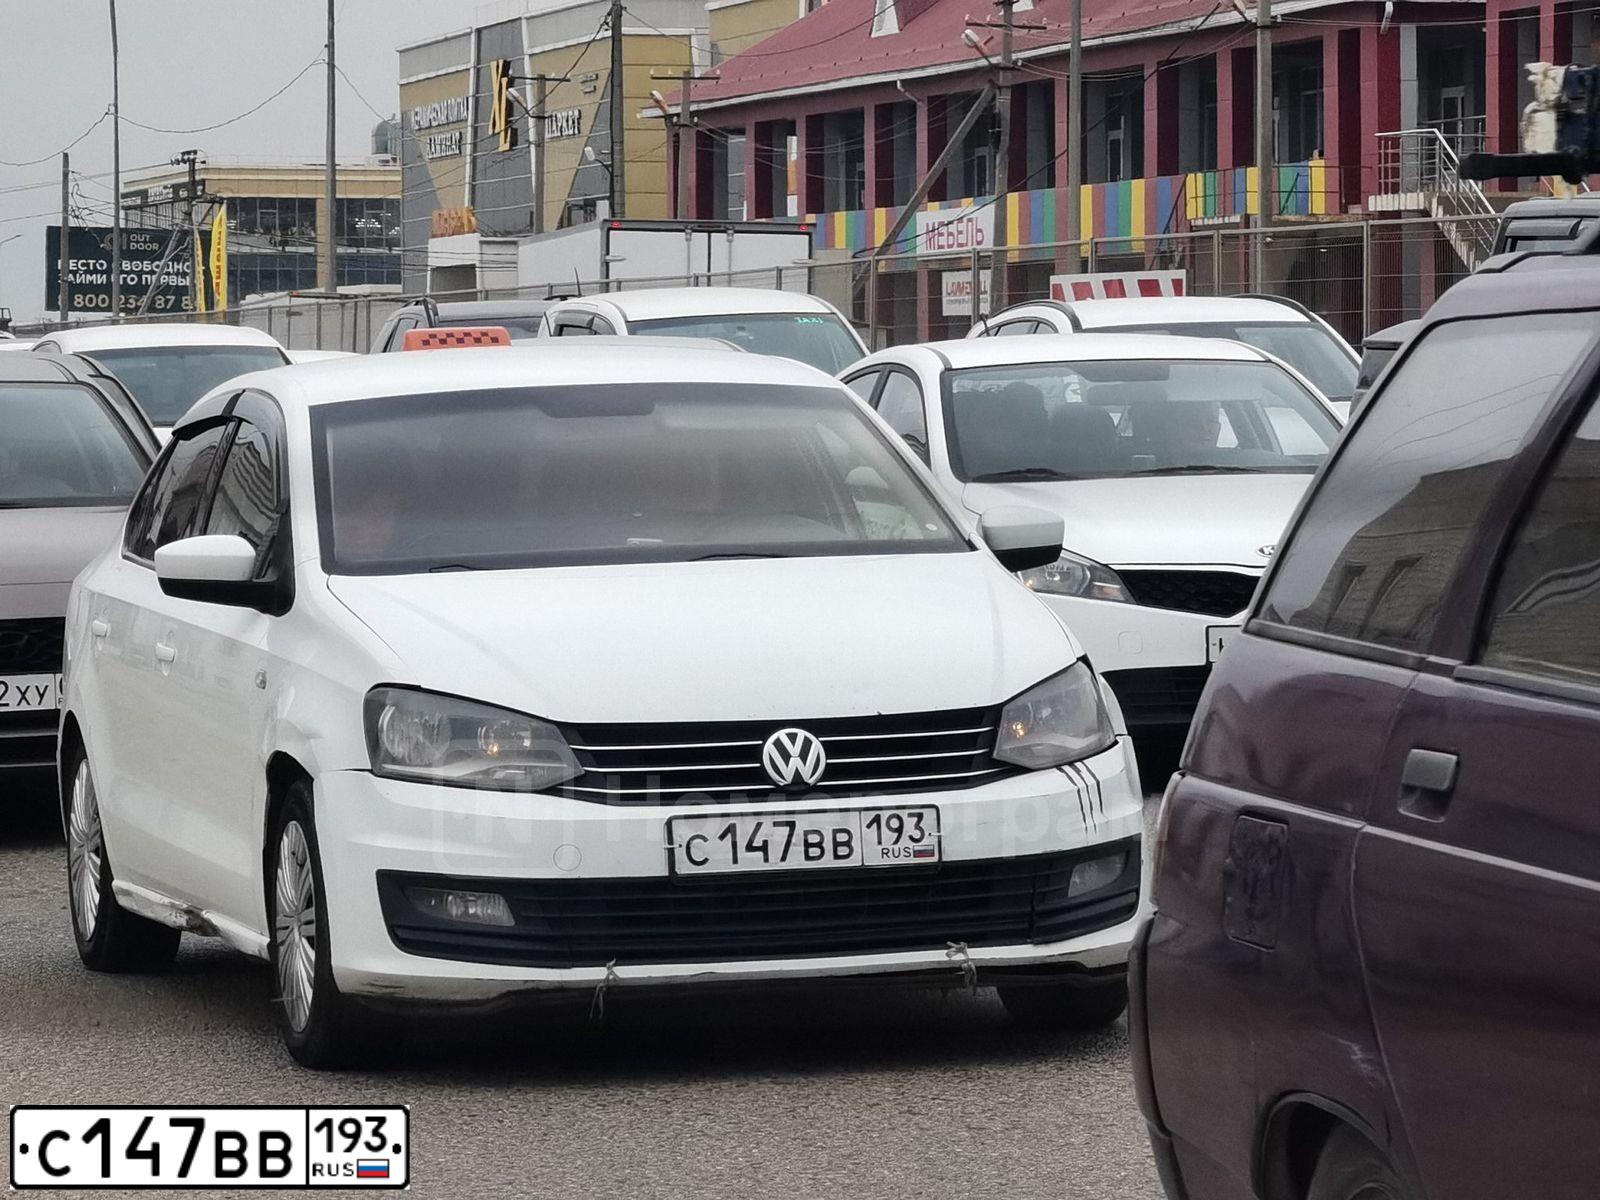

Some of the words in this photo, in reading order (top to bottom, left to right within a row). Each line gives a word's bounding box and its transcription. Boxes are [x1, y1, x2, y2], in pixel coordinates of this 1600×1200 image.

[489, 59, 513, 151] XL
[130, 233, 150, 242] OUT
[926, 217, 985, 251] МЕБЕЛЬ
[130, 242, 159, 251] DOOR
[113, 260, 191, 274] ВОБОДНО
[111, 274, 138, 285] ГО
[74, 294, 109, 308] 800
[686, 821, 854, 866] С147ВВ
[865, 812, 926, 846] 193
[881, 846, 912, 859] RUS
